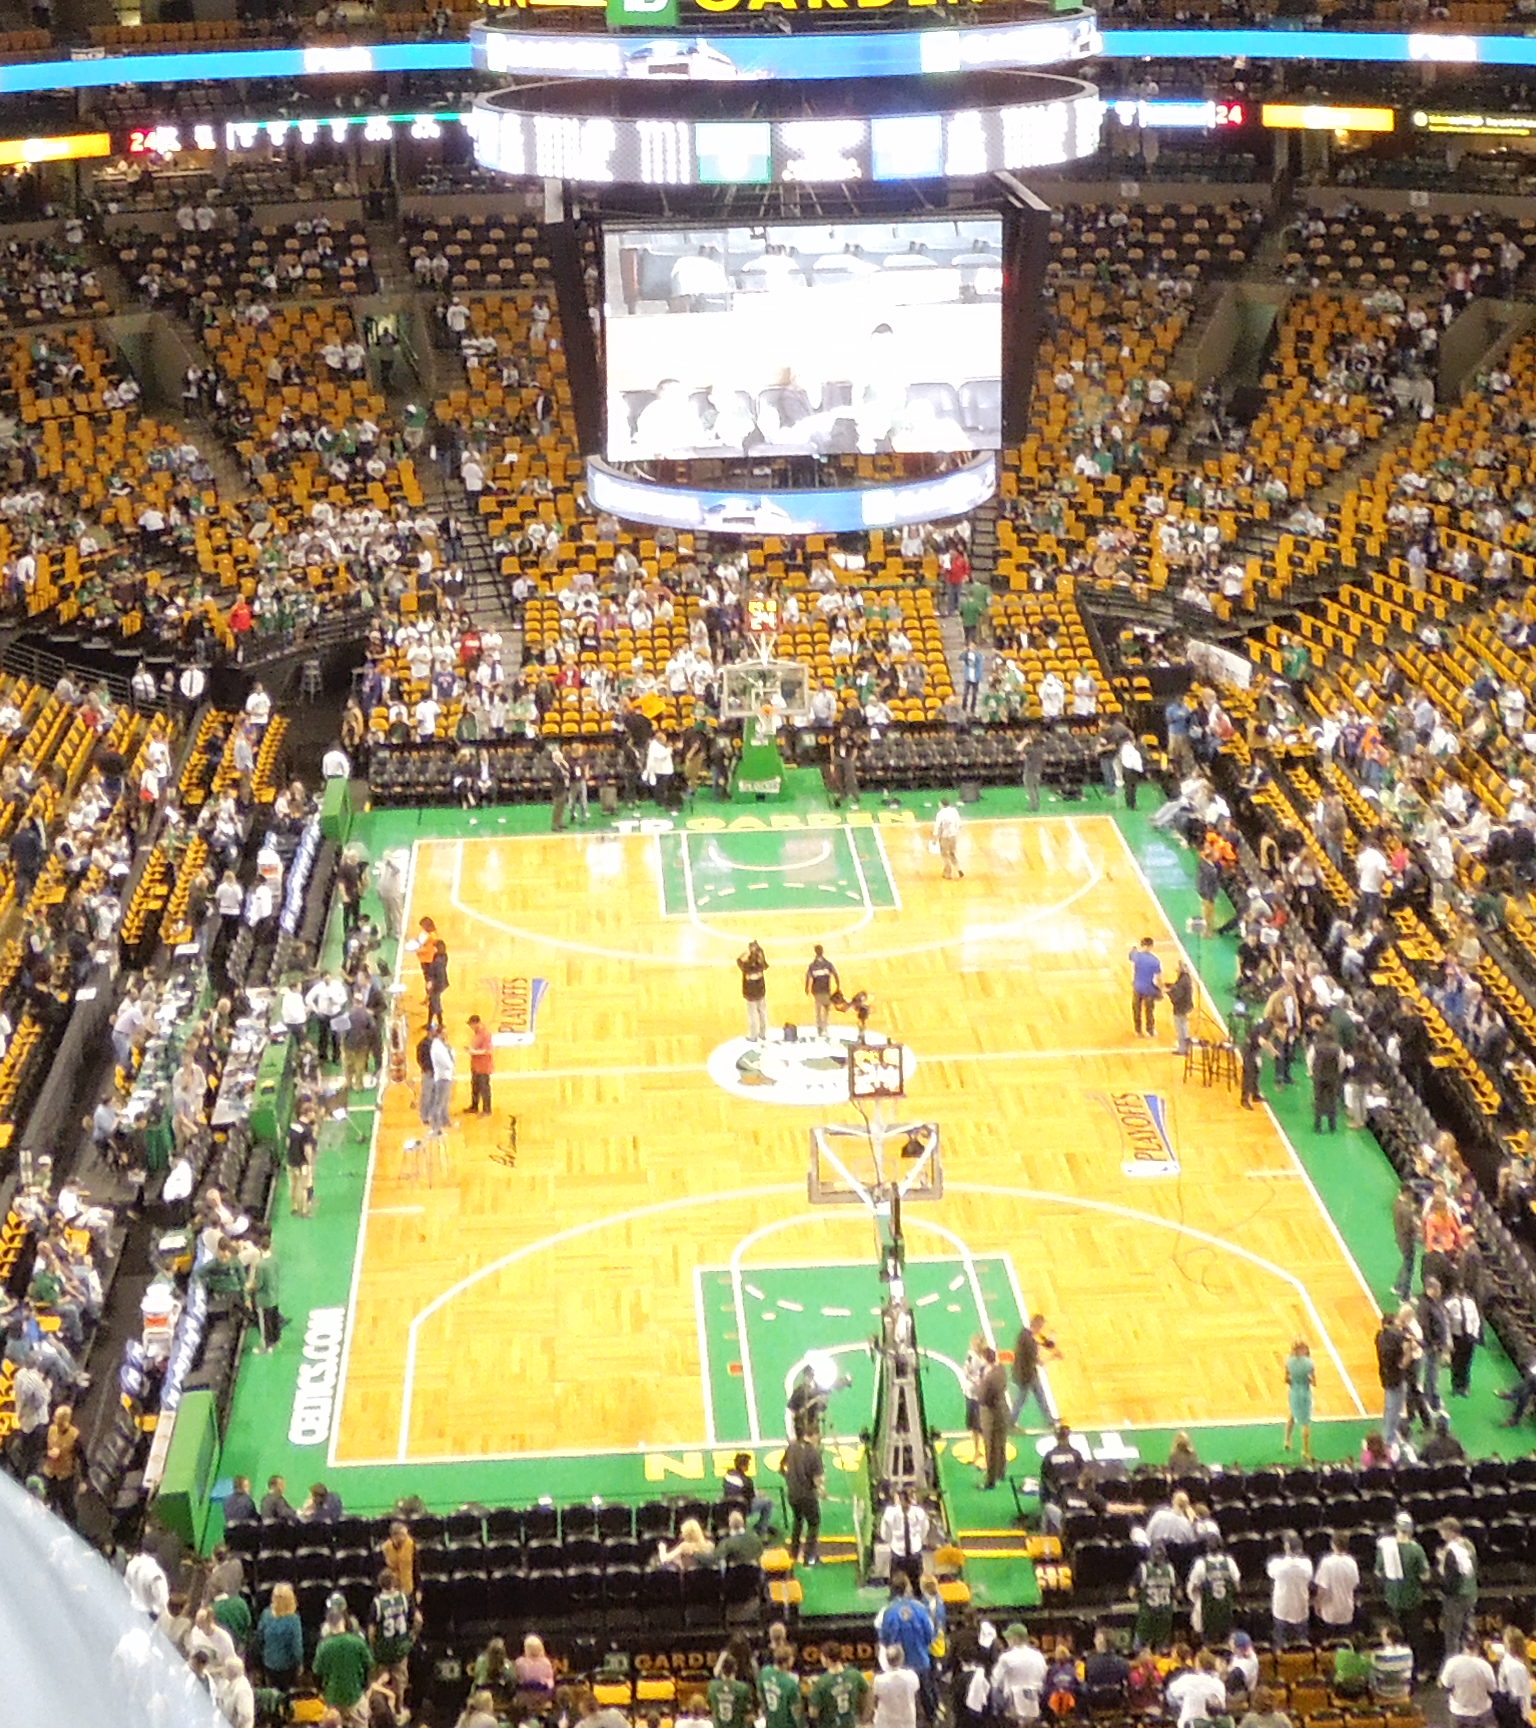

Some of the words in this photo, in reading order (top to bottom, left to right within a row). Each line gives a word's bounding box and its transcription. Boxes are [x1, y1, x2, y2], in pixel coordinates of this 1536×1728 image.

[1216, 105, 1243, 124] 24
[611, 819, 674, 833] TD
[686, 811, 915, 830] GARDEN
[498, 977, 528, 1033] PLAYOFFS
[1111, 1093, 1167, 1161] PLAYOFFS
[288, 1307, 346, 1445] CELTICS.COM
[635, 1651, 717, 1671] GARDE
